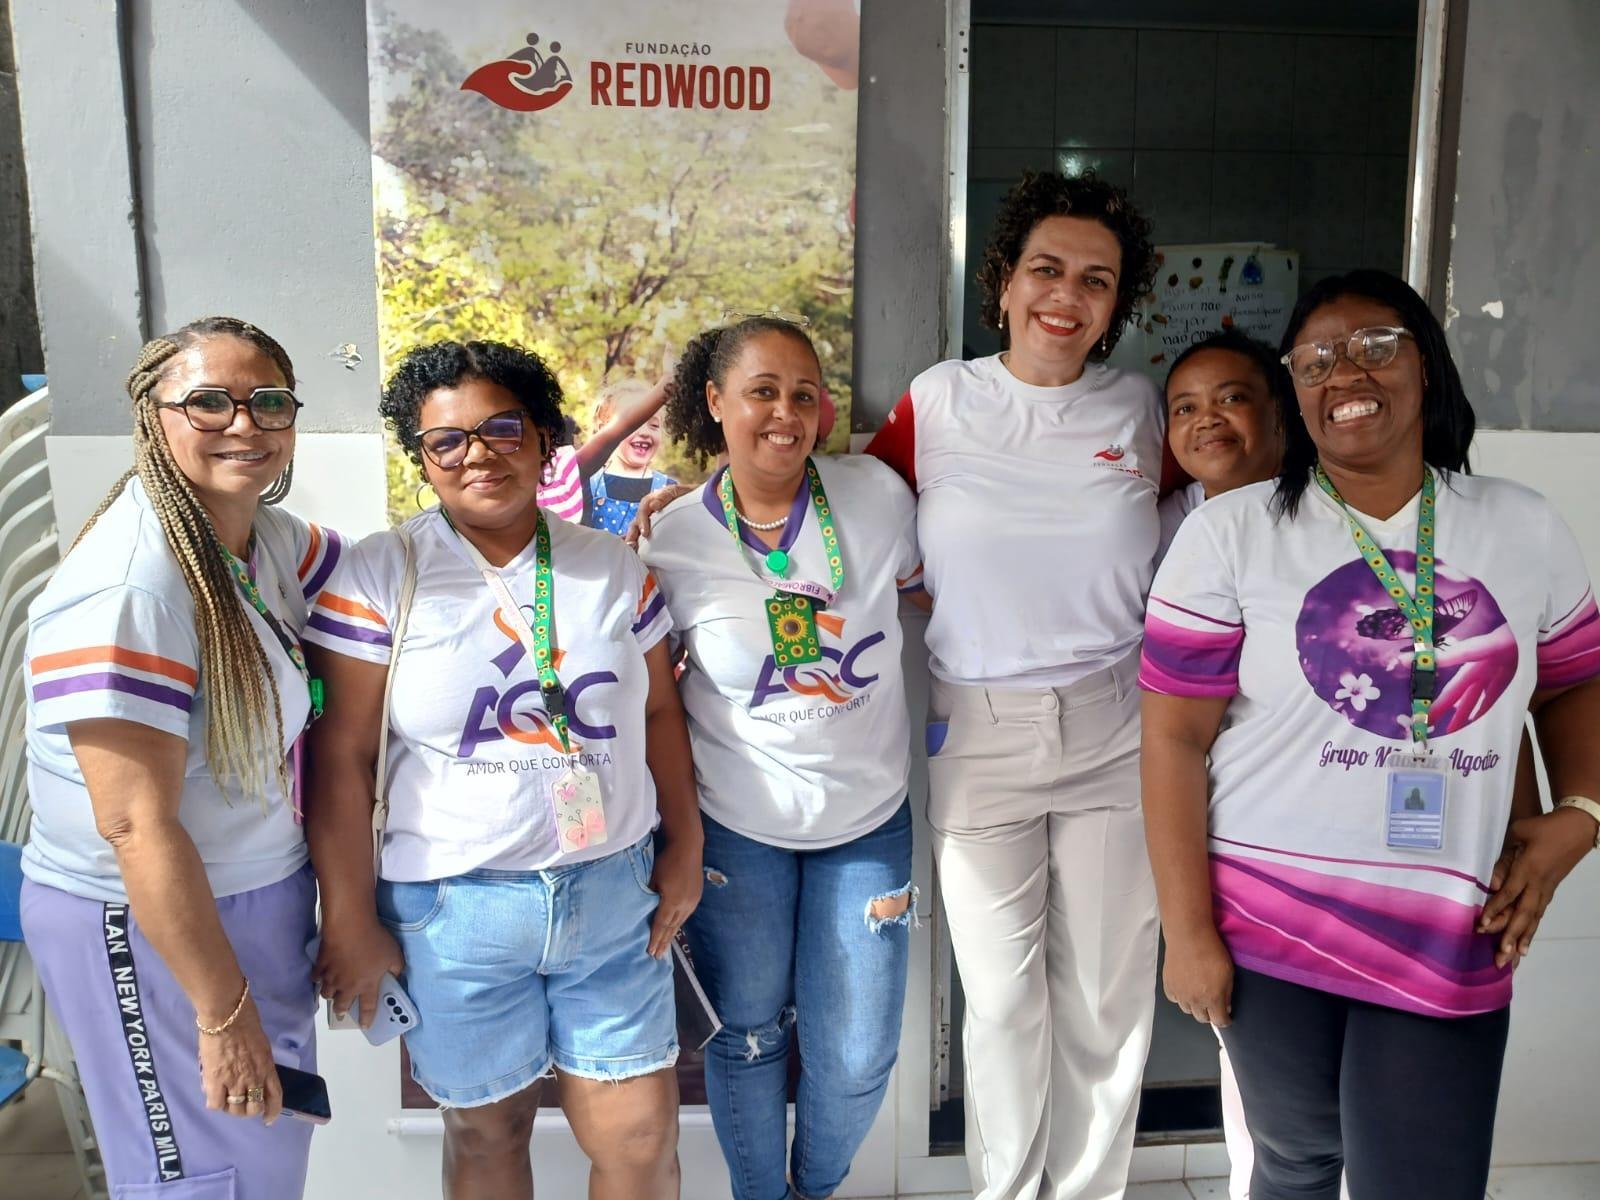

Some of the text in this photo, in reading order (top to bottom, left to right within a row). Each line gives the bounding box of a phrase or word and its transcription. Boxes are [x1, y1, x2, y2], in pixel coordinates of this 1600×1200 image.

[625, 42, 711, 57] FUNDAÇÃO
[590, 61, 771, 111] REDWOOD
[457, 670, 619, 757] AQC
[789, 708, 815, 724] QUE
[508, 759, 539, 773] QUE
[541, 753, 612, 770] CONFORTA
[1319, 740, 1370, 771] Grupo
[113, 966, 140, 1016] NEW
[125, 1018, 154, 1075] YORK
[139, 1078, 170, 1132] PARIS
